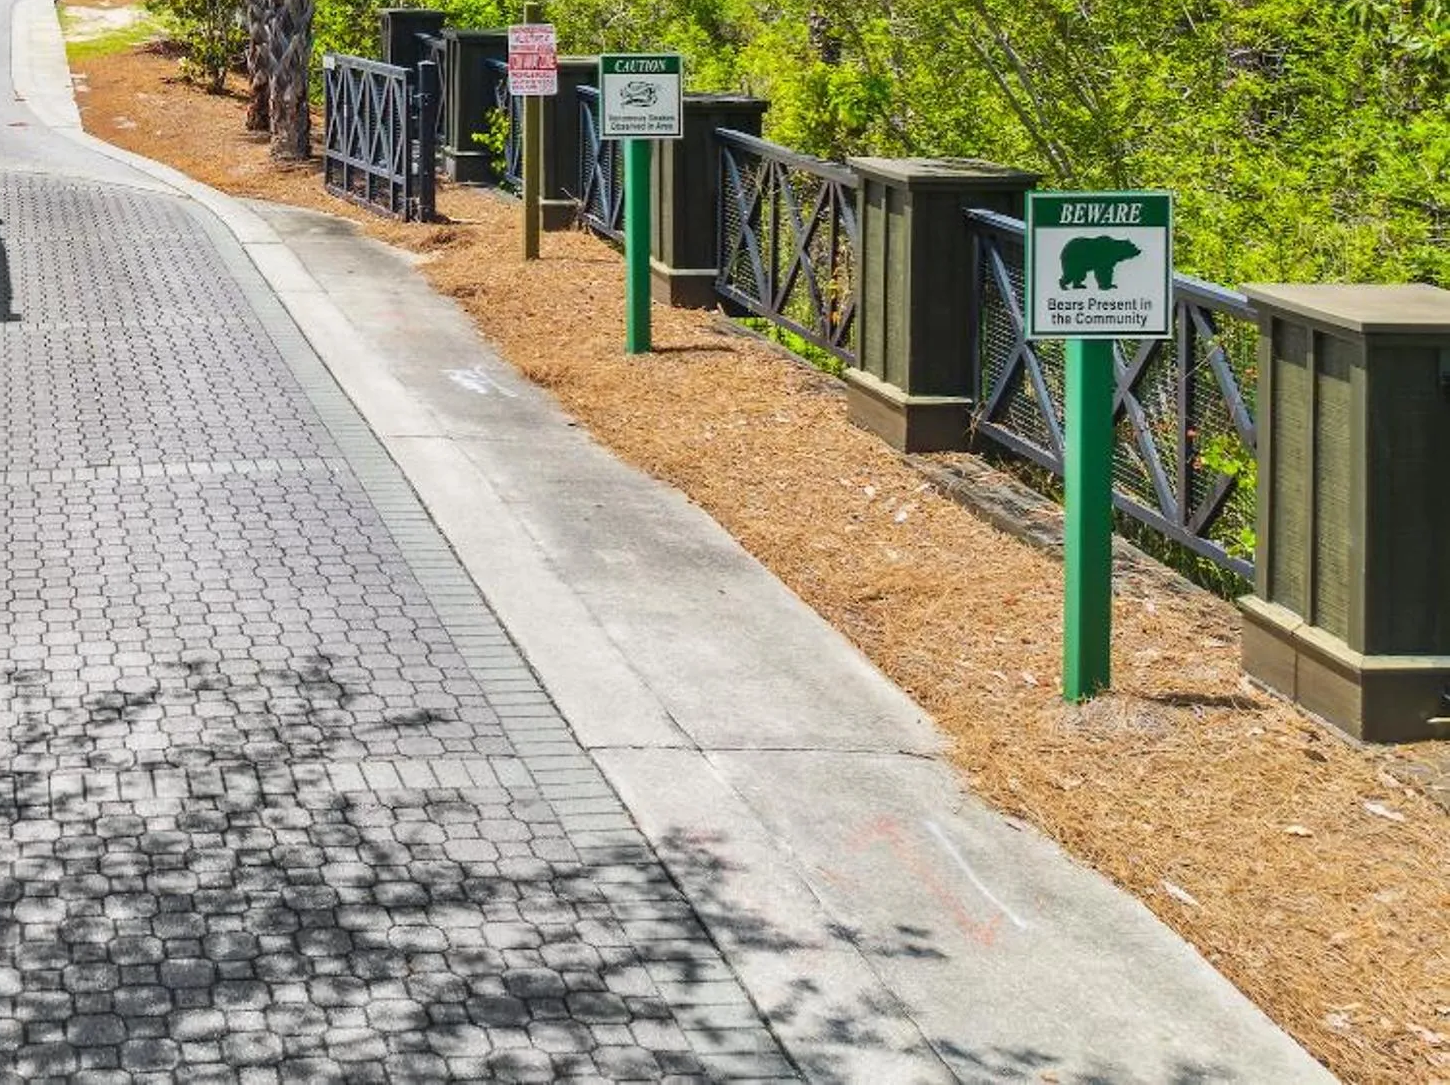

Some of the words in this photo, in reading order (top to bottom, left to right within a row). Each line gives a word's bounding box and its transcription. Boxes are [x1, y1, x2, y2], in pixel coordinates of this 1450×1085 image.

[614, 59, 666, 72] CAUTION
[1059, 203, 1143, 224] BEWARE
[1047, 298, 1085, 311] Bears
[1088, 298, 1138, 311] Present
[1140, 298, 1152, 311] in
[1051, 312, 1072, 325] the
[1075, 312, 1148, 327] Community
